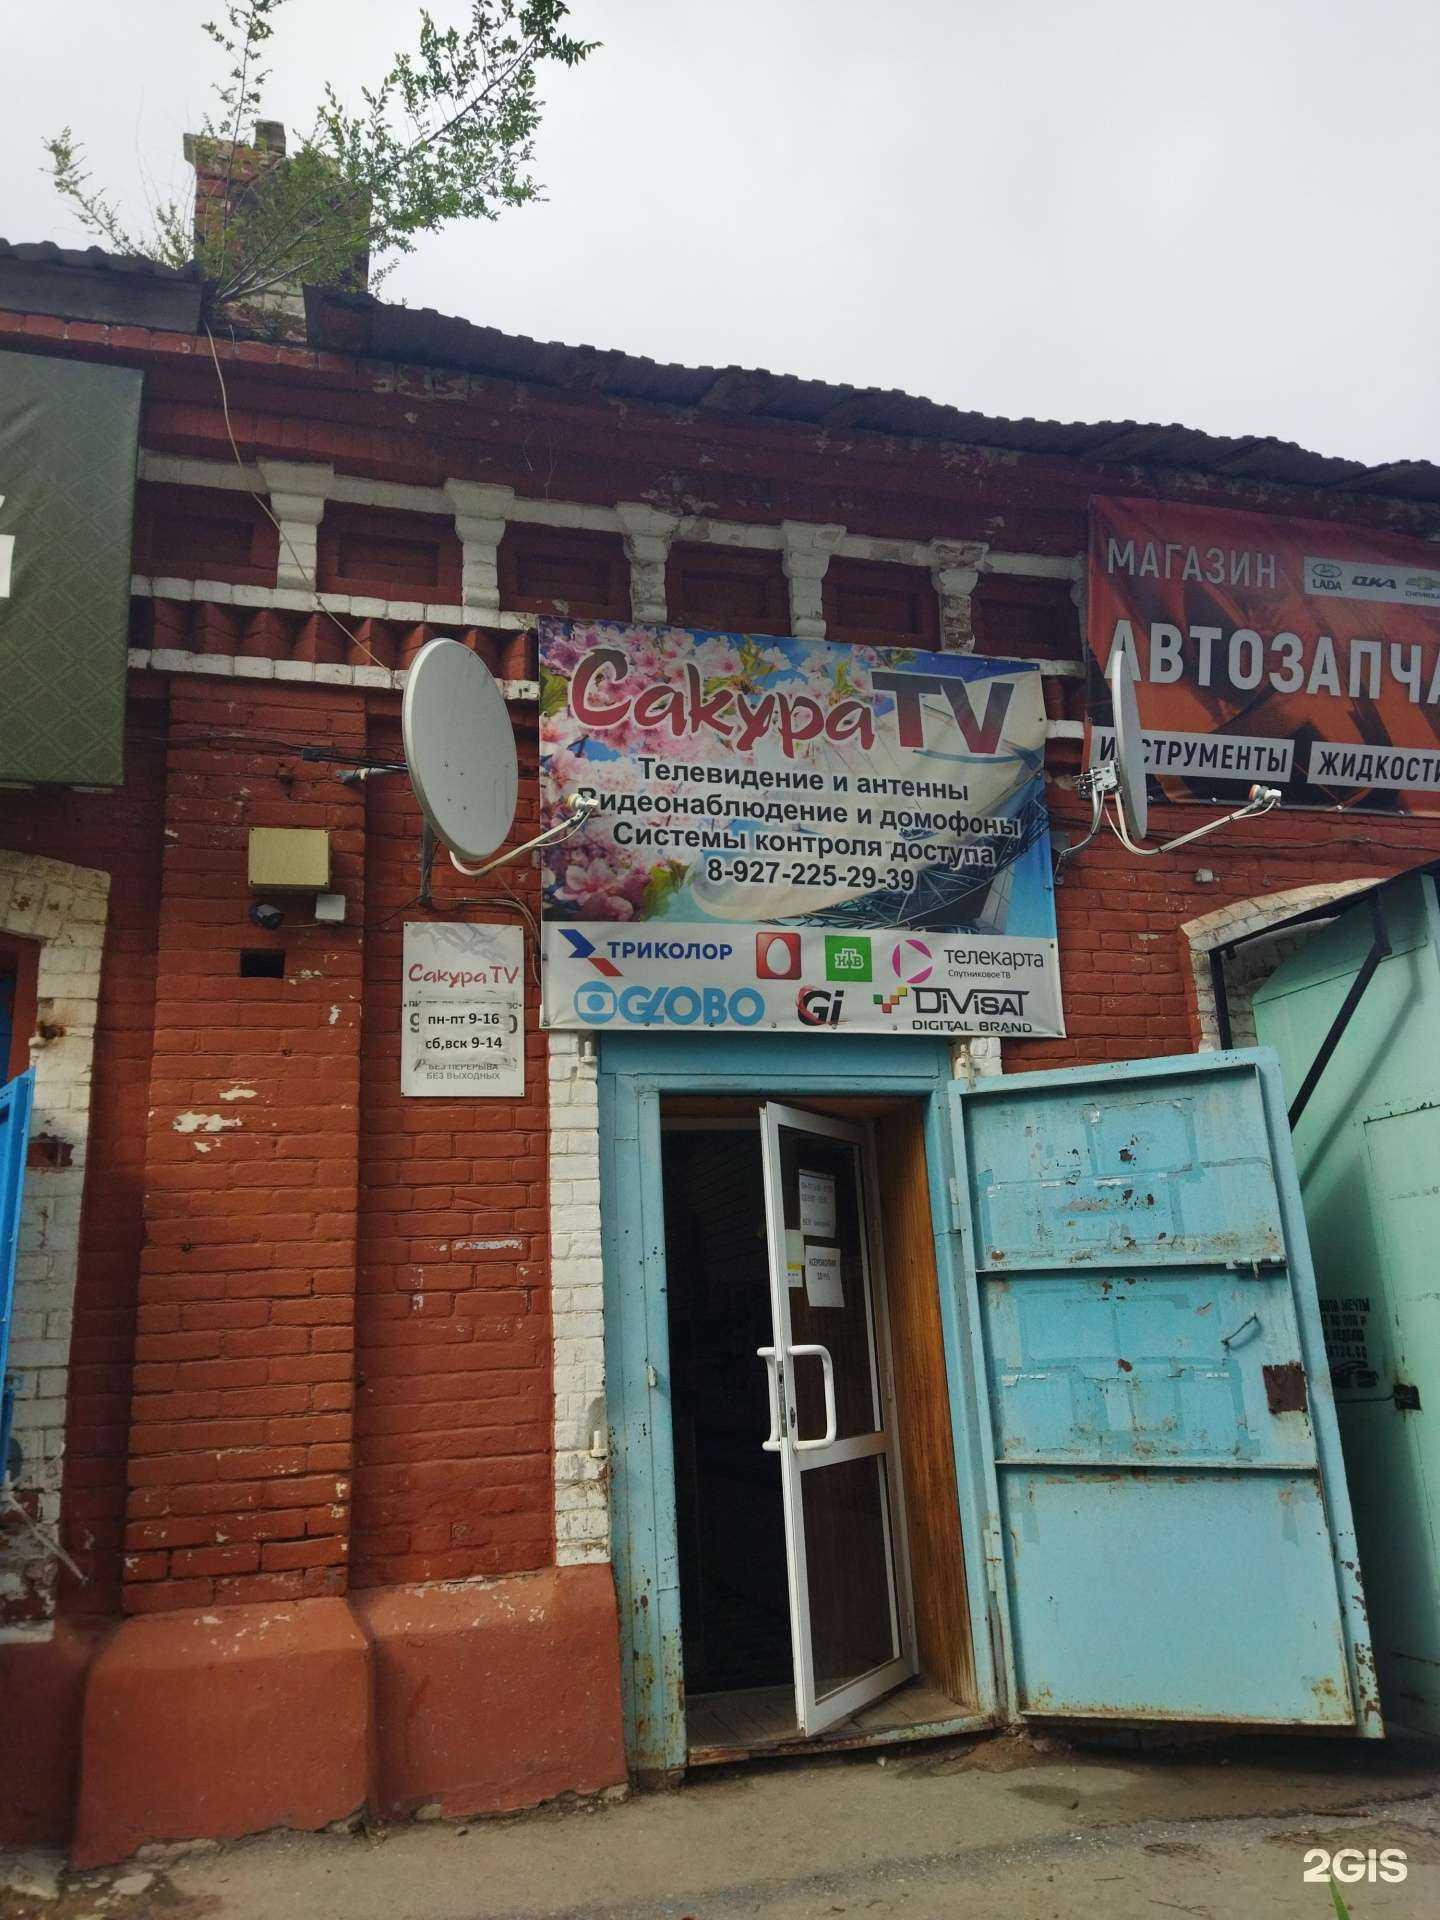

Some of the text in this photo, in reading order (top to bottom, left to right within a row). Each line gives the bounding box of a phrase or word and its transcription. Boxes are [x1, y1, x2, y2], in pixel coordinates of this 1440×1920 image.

[1107, 538, 1277, 588] МАГАЗИН
[1312, 579, 1343, 591] LADA
[571, 647, 1016, 758] Сакура TV
[1099, 736, 1440, 784] ИТРУМЕНТЫ ЖИДКОСТ
[637, 757, 968, 801] Телевидение и антенны
[856, 807, 872, 825] и
[879, 809, 1020, 837] домофоны
[612, 821, 994, 868] Системы контроля доступа
[707, 858, 915, 891] 8-927-225-29-39
[607, 941, 733, 960] ТРИКОЛОР
[408, 963, 520, 988] Сакура TV
[948, 970, 1012, 979] Спутниковое ТВ
[619, 985, 766, 1025] GLOBO
[428, 1015, 465, 1025] пн-пт
[468, 1013, 500, 1025] 9-16
[912, 1020, 1033, 1034] DIGITAL BRAND
[425, 1036, 503, 1051] сб,вск 9-14
[426, 1072, 501, 1081] БЕЗ ВЫХОДНЫХ
